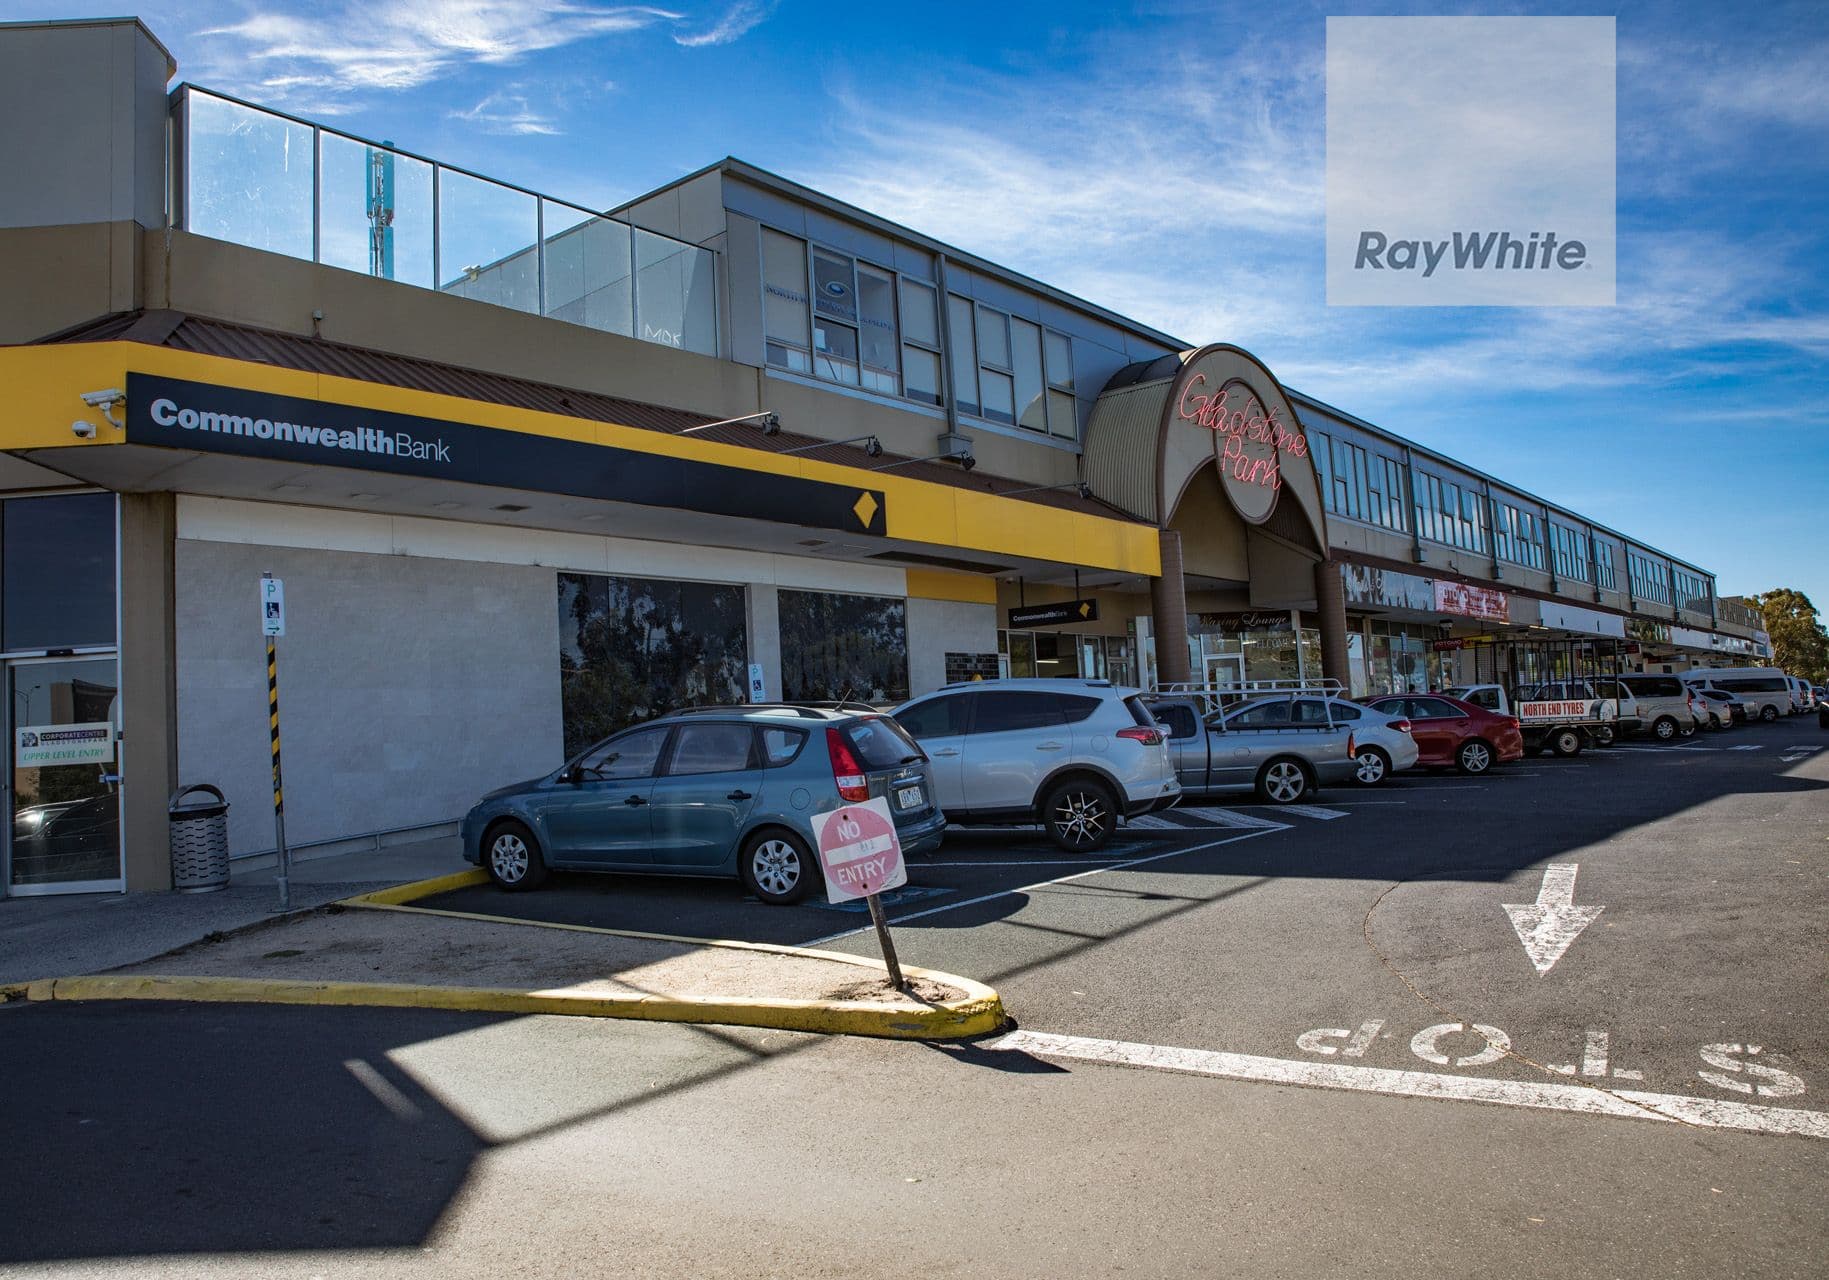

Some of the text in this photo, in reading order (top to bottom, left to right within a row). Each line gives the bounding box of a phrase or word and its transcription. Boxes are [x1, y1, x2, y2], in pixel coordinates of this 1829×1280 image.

[1180, 374, 1308, 457] Gladstone
[150, 398, 451, 462] CommonwealthBank
[1222, 435, 1282, 490] Park
[267, 584, 276, 598] P
[1241, 612, 1287, 627] Lounge
[1523, 702, 1584, 717] NORTH END TYRES
[24, 747, 105, 761] UPPER LEVEL ENTRY
[837, 821, 861, 842] NO
[837, 857, 887, 885] ENTRY
[1296, 1019, 1806, 1098] STOP
